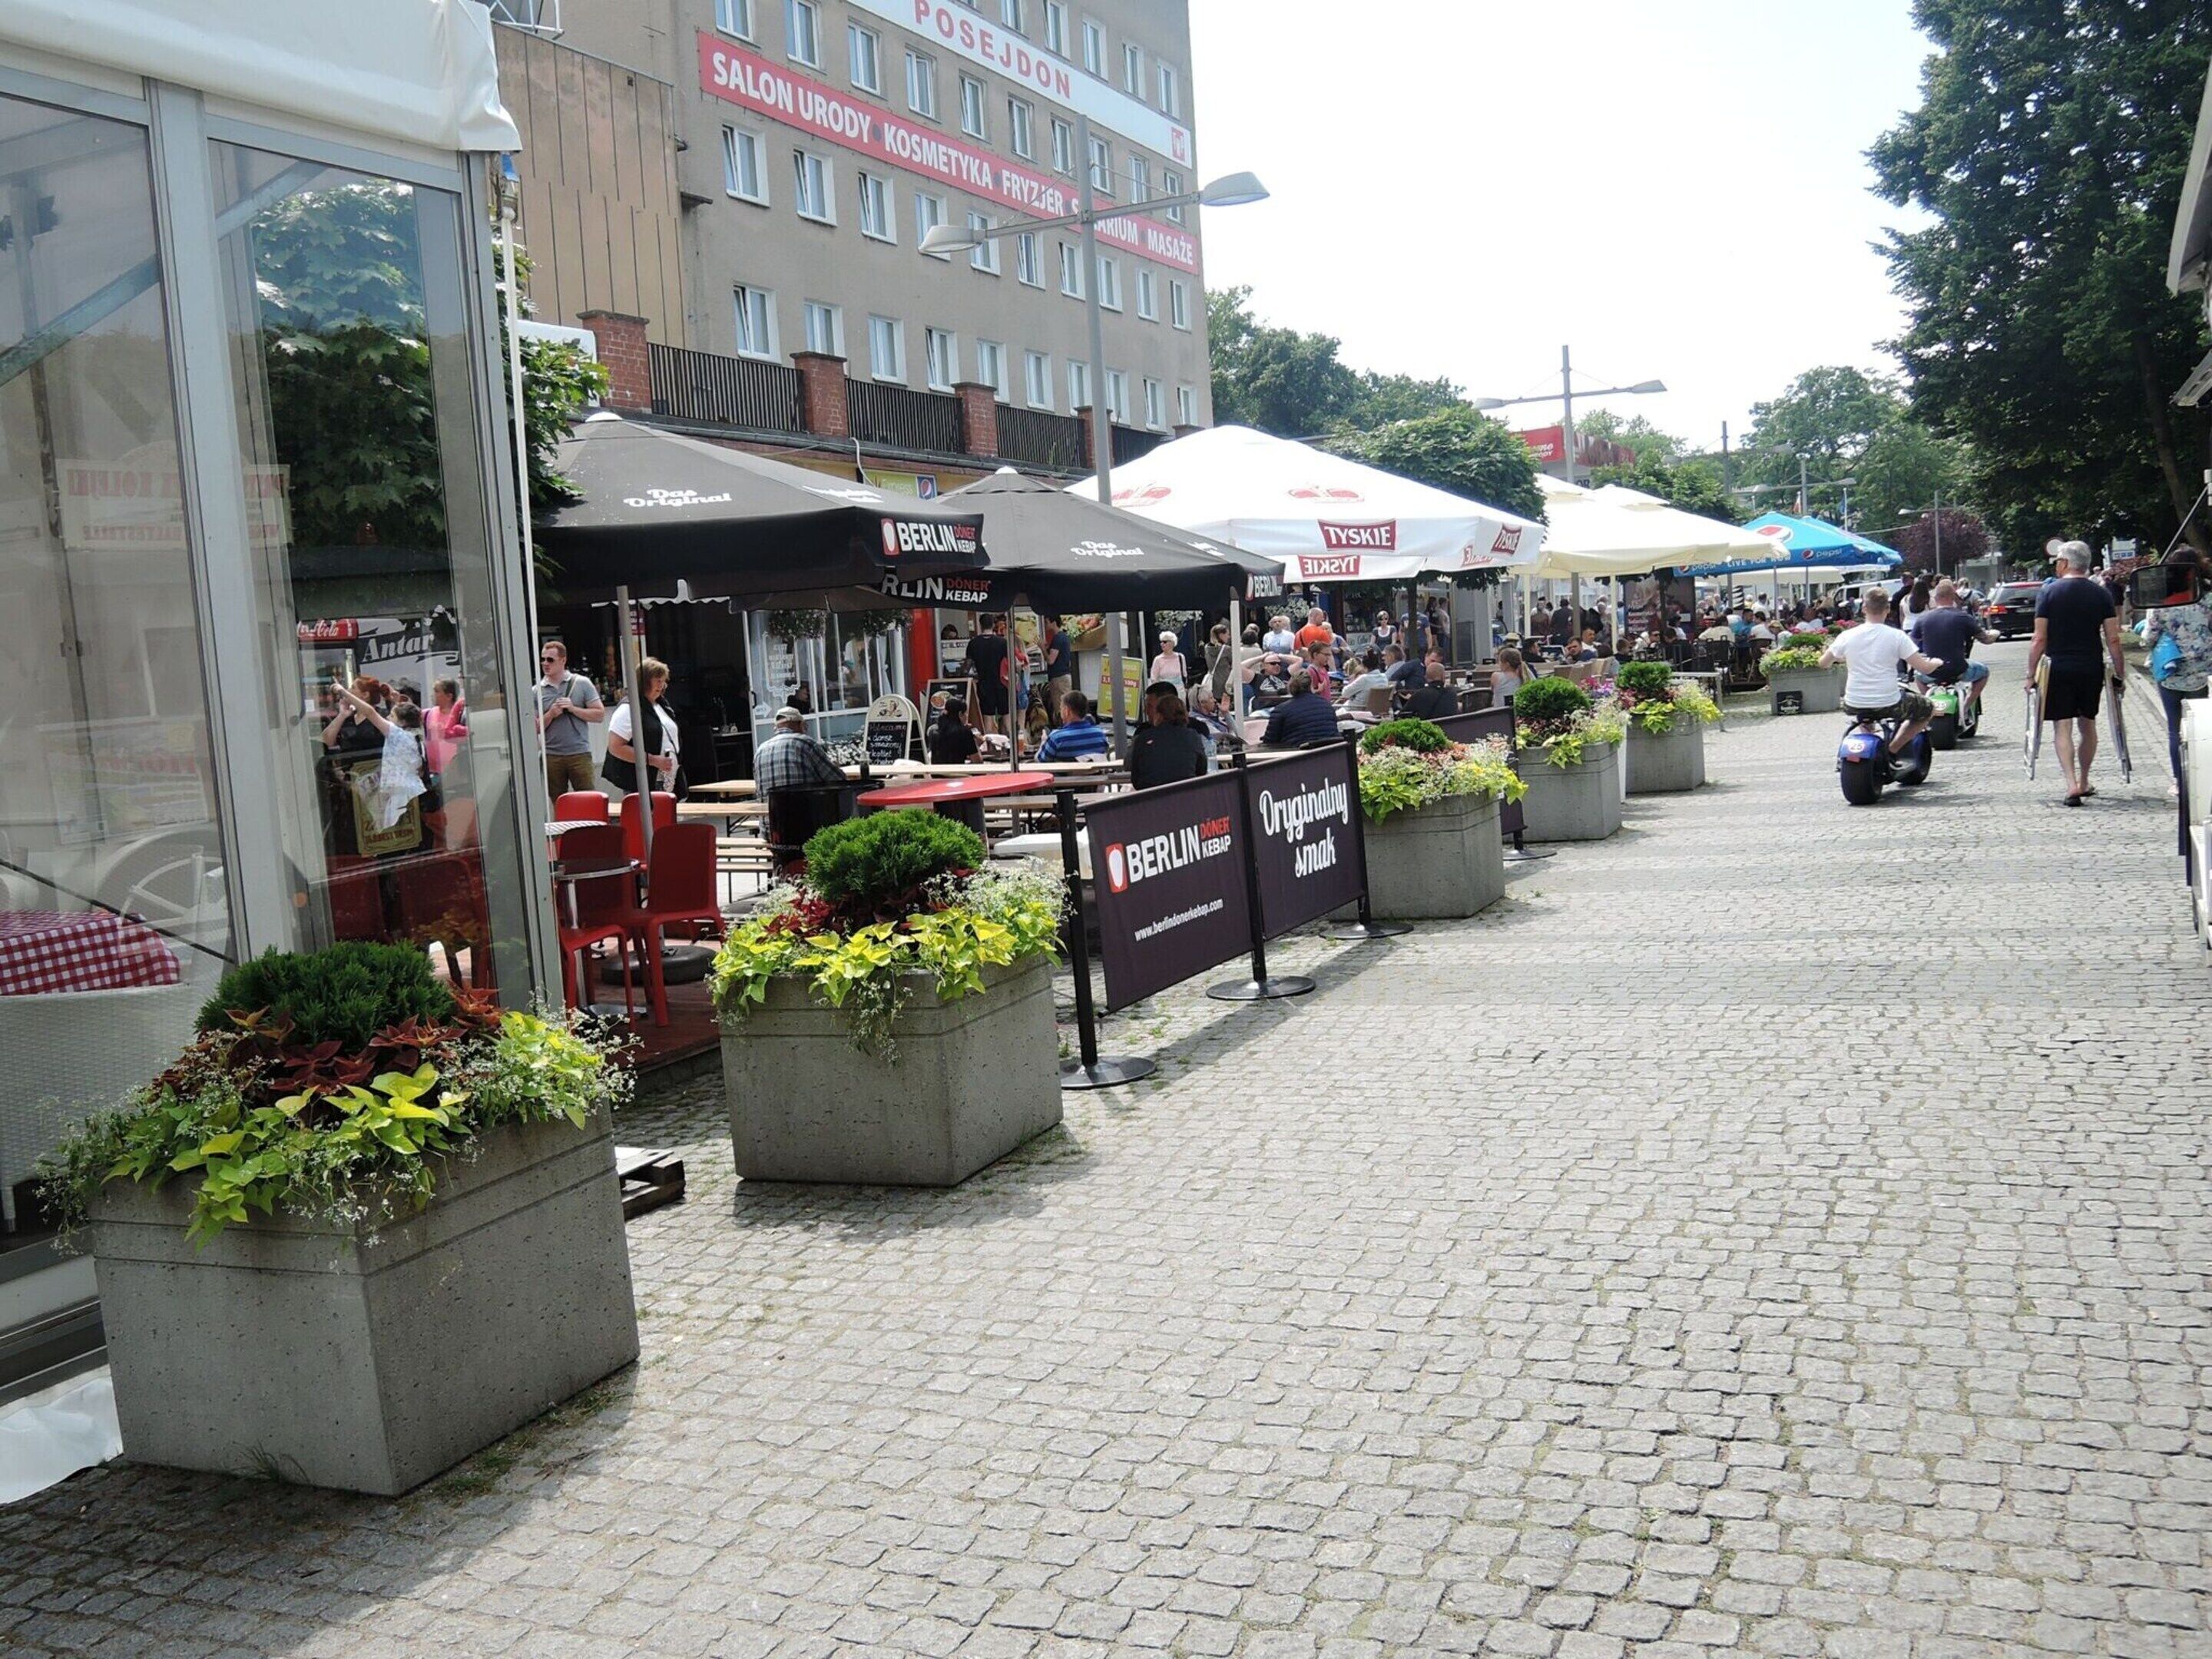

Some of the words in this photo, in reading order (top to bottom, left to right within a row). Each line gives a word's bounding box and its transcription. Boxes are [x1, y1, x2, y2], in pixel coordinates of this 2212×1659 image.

[914, 0, 1071, 99] POSEJDON
[711, 51, 793, 114] SALON
[799, 86, 871, 144] URODY
[883, 121, 994, 191] KOSMETYKA
[1002, 167, 1065, 217] FRYZJER
[1071, 197, 1138, 246] SARIUM
[1147, 227, 1194, 266] MASAŻE
[623, 492, 733, 508] Original
[647, 488, 697, 499] Das
[896, 522, 959, 553] BERLIN
[956, 539, 977, 554] KEBAP
[1081, 540, 1118, 549] Das
[1324, 525, 1392, 547] TYSKIE
[1071, 547, 1144, 558] Original
[1816, 548, 1843, 558] pepsi
[881, 573, 944, 601] RLIN
[945, 577, 989, 591] DÖNER
[945, 589, 988, 604] KEBAP
[1253, 575, 1277, 598] BERLIN
[362, 633, 435, 663] Antar
[1259, 777, 1348, 843] Oryginalny
[1126, 825, 1201, 883] BERLIN
[1199, 816, 1231, 839] DÖNER
[1201, 834, 1231, 859] KEBAP
[1295, 826, 1336, 878] smak
[1134, 898, 1224, 942] www.berlindonerkebap.com
